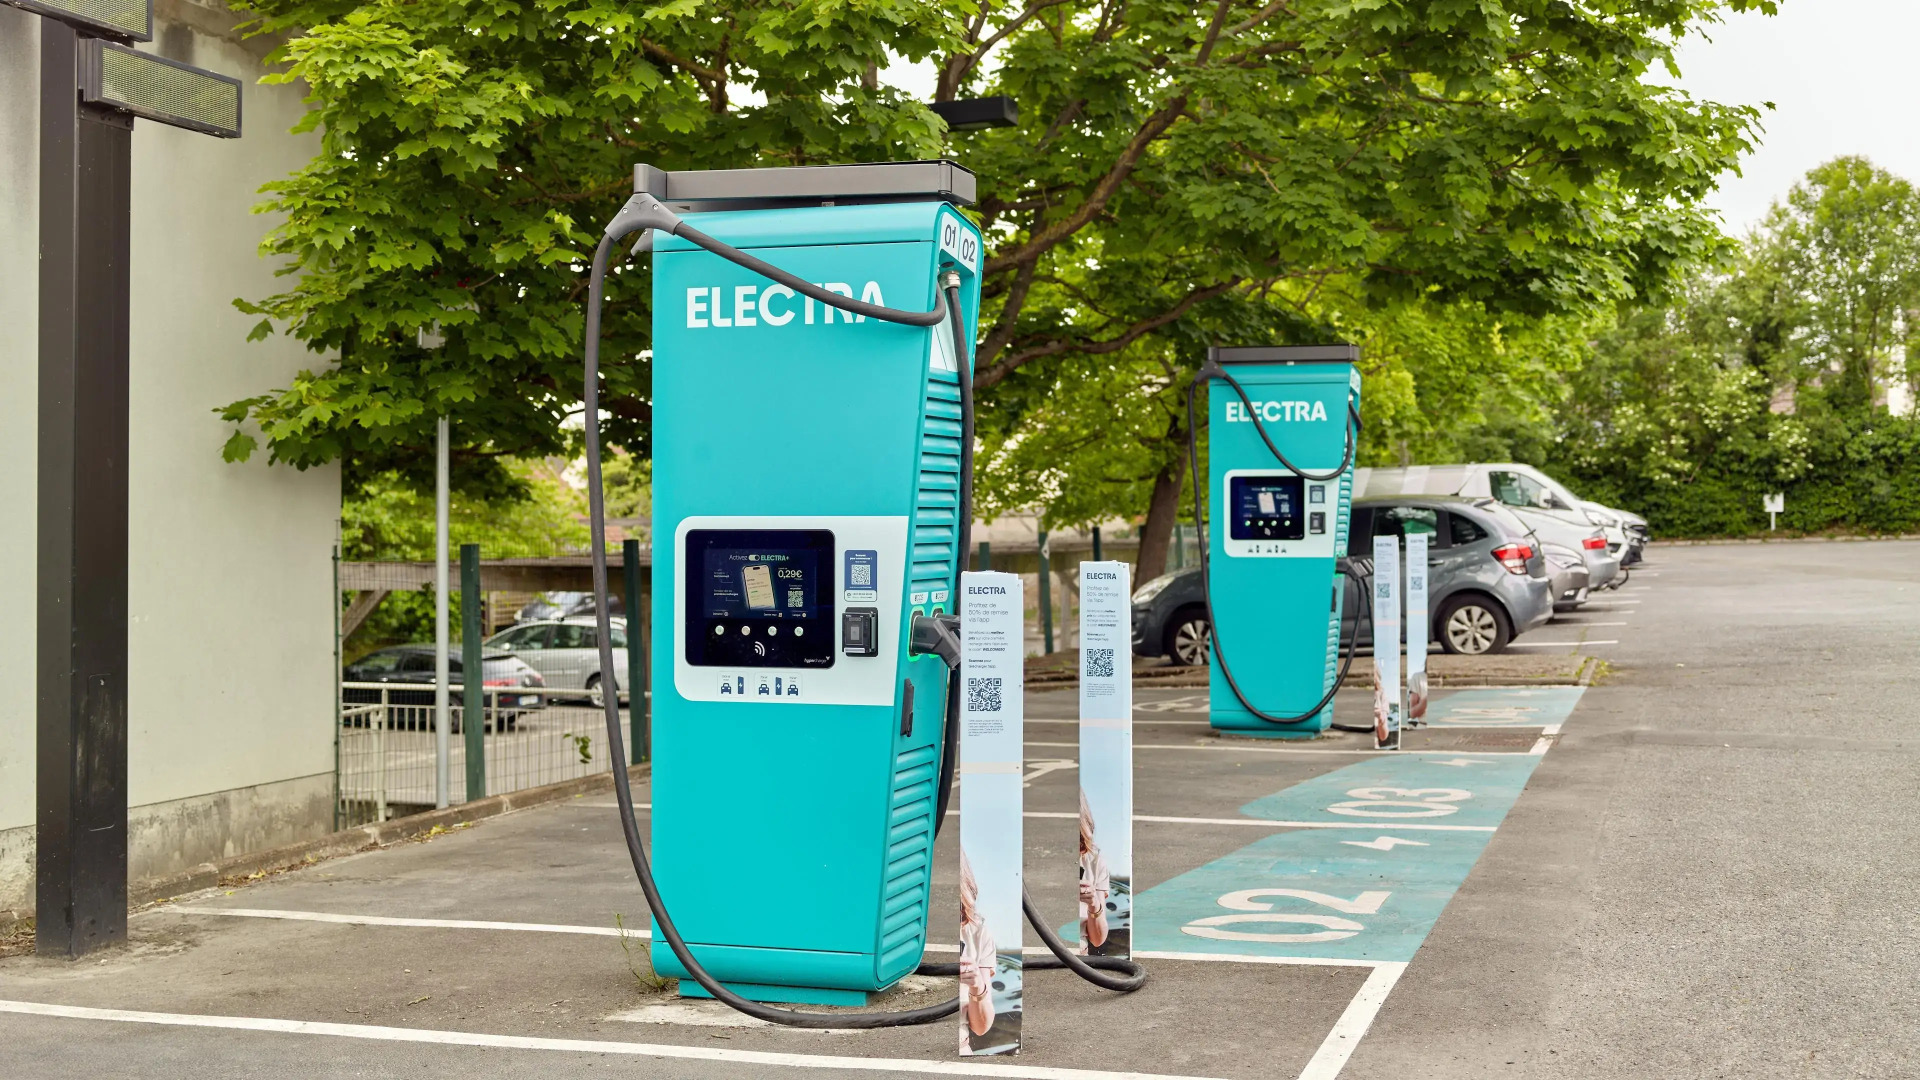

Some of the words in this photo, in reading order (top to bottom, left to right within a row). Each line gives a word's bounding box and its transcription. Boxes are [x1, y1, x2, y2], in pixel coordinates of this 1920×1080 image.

[944, 224, 957, 249] 01
[962, 238, 976, 263] 02
[686, 281, 888, 328] ELECTRA
[1226, 400, 1327, 422] ELECTRA
[777, 569, 803, 579] 0,29€
[1086, 572, 1117, 580] ELECTRA
[968, 586, 1006, 595] ELECTRA
[1326, 787, 1472, 818] 03
[1180, 888, 1392, 943] 02
